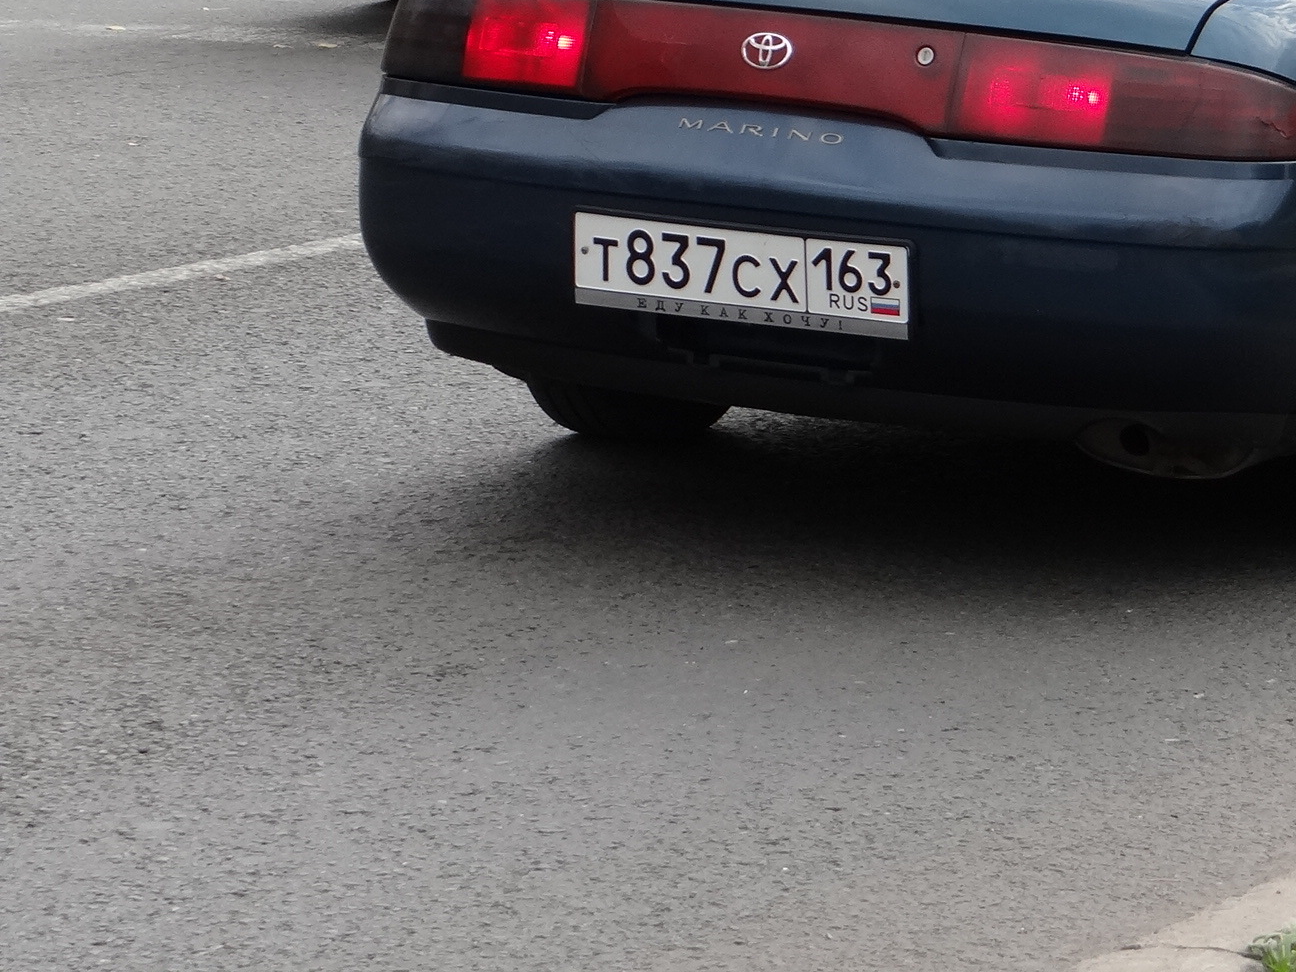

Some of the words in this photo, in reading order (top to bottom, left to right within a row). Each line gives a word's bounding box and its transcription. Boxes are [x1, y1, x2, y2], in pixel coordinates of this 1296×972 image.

[678, 117, 844, 145] MARINO
[811, 246, 893, 296] 163
[636, 297, 684, 313] ЕДУ
[700, 304, 749, 320] КАК
[764, 312, 843, 330] ХОЧУ!
[829, 293, 869, 312] RUS
